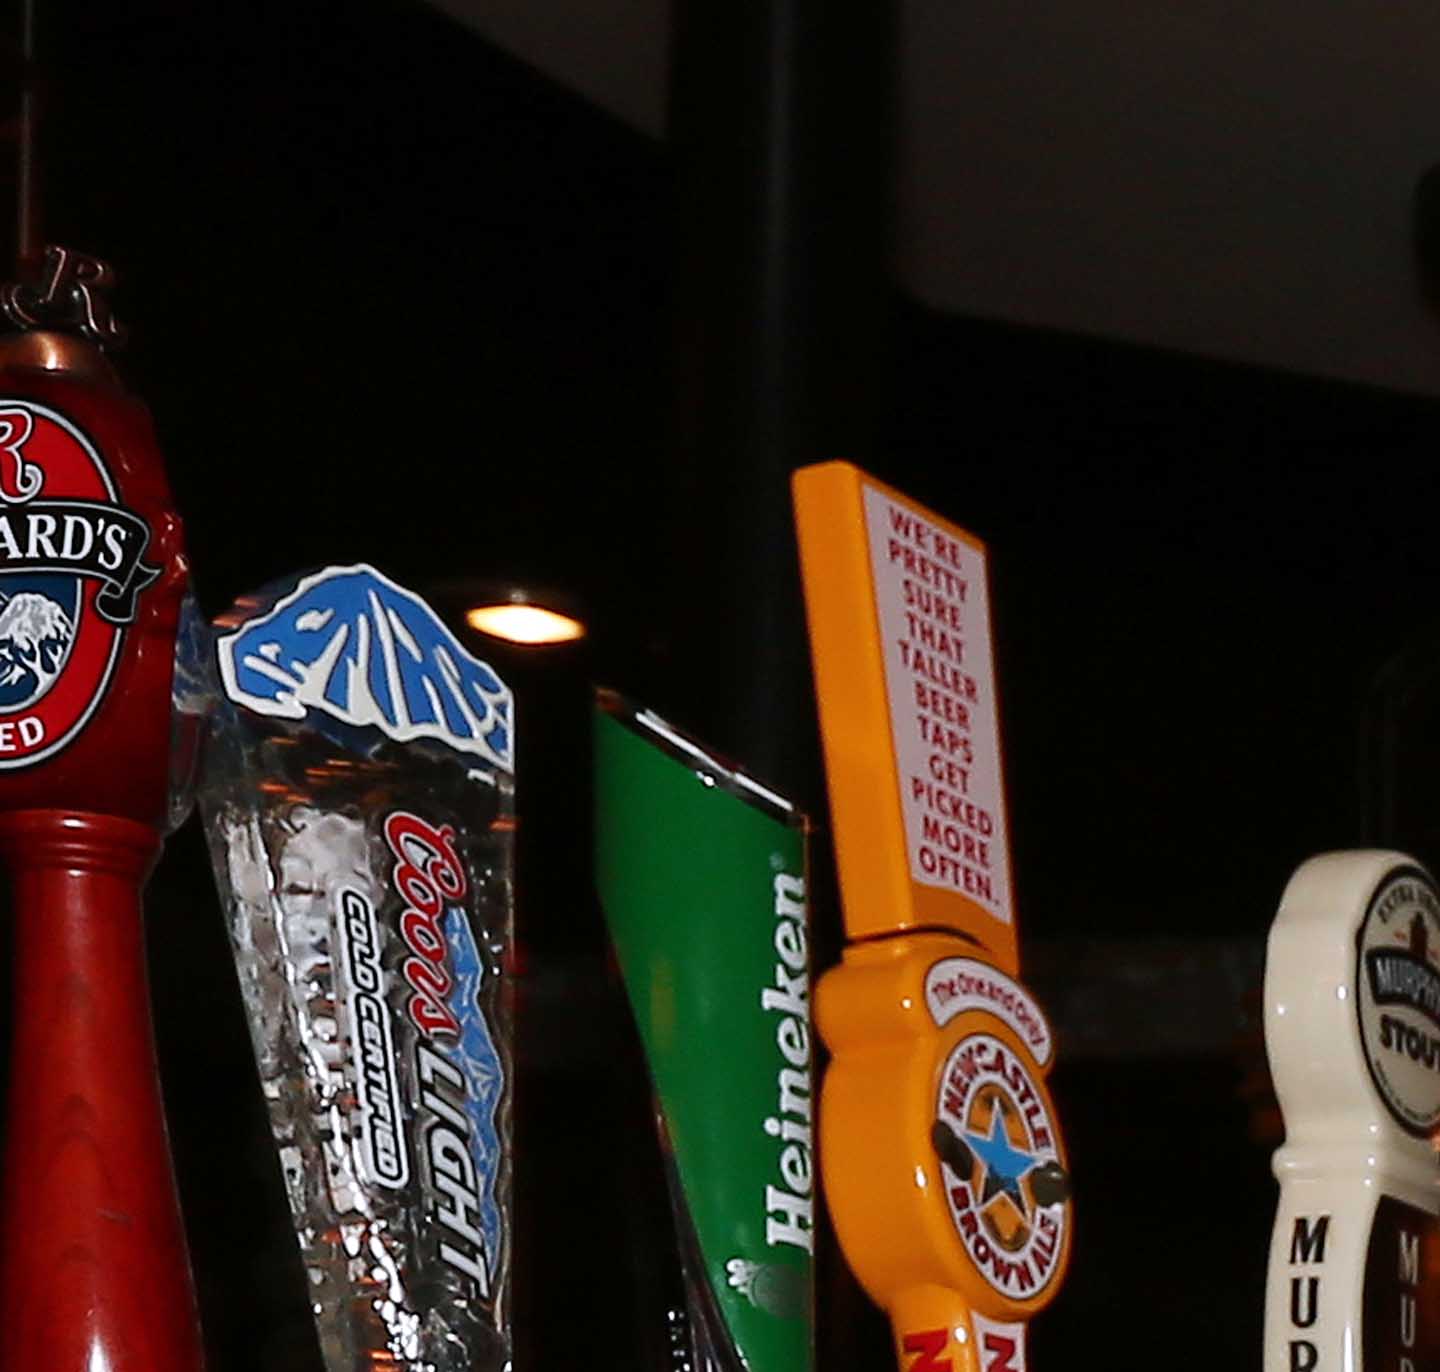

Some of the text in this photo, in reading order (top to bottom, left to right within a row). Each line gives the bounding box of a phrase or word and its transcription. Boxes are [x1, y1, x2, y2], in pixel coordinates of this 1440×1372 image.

[889, 538, 968, 603] PRETTY
[904, 579, 961, 632] SURE
[906, 610, 963, 665] THAT
[898, 639, 979, 704] TALLER
[915, 681, 971, 733] BEER
[917, 714, 974, 765] TAPS
[929, 753, 969, 794] GET
[911, 775, 993, 838] PICKED
[923, 812, 990, 870] MORE
[342, 889, 404, 1183] COLD CERTIFIED
[385, 811, 492, 1300] Coors LIGHT
[761, 873, 814, 1256] Heineken
